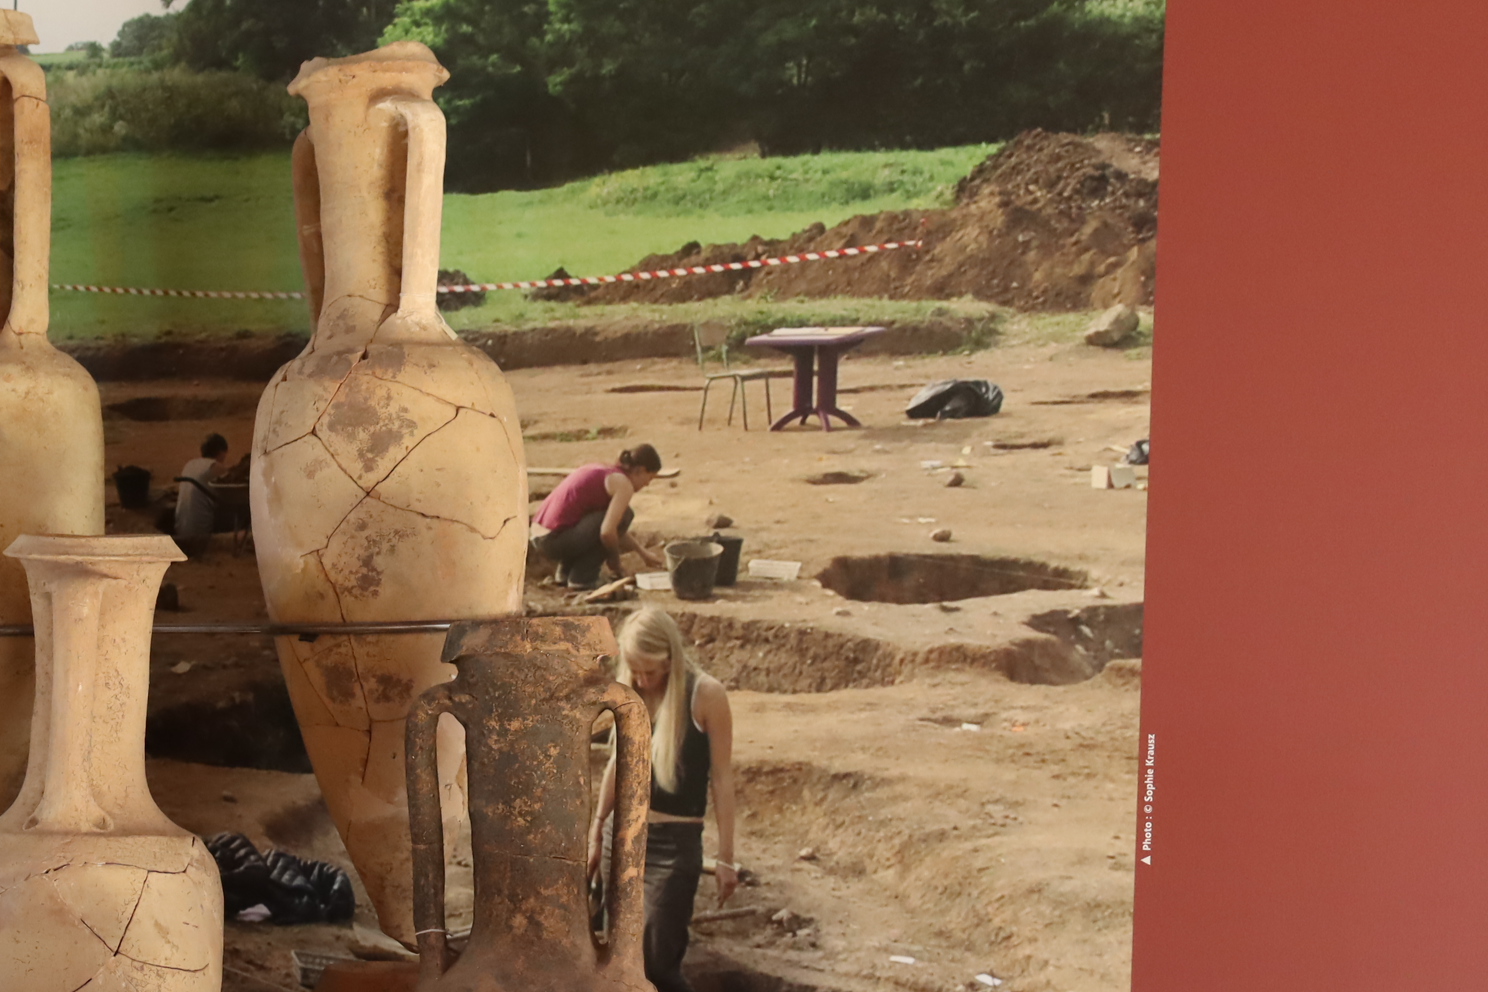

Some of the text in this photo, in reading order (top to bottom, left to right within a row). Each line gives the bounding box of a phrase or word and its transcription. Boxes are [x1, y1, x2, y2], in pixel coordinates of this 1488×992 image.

[1145, 734, 1155, 766] Krausz
[1144, 769, 1155, 801] Sophie
[1143, 822, 1152, 850] Photo
